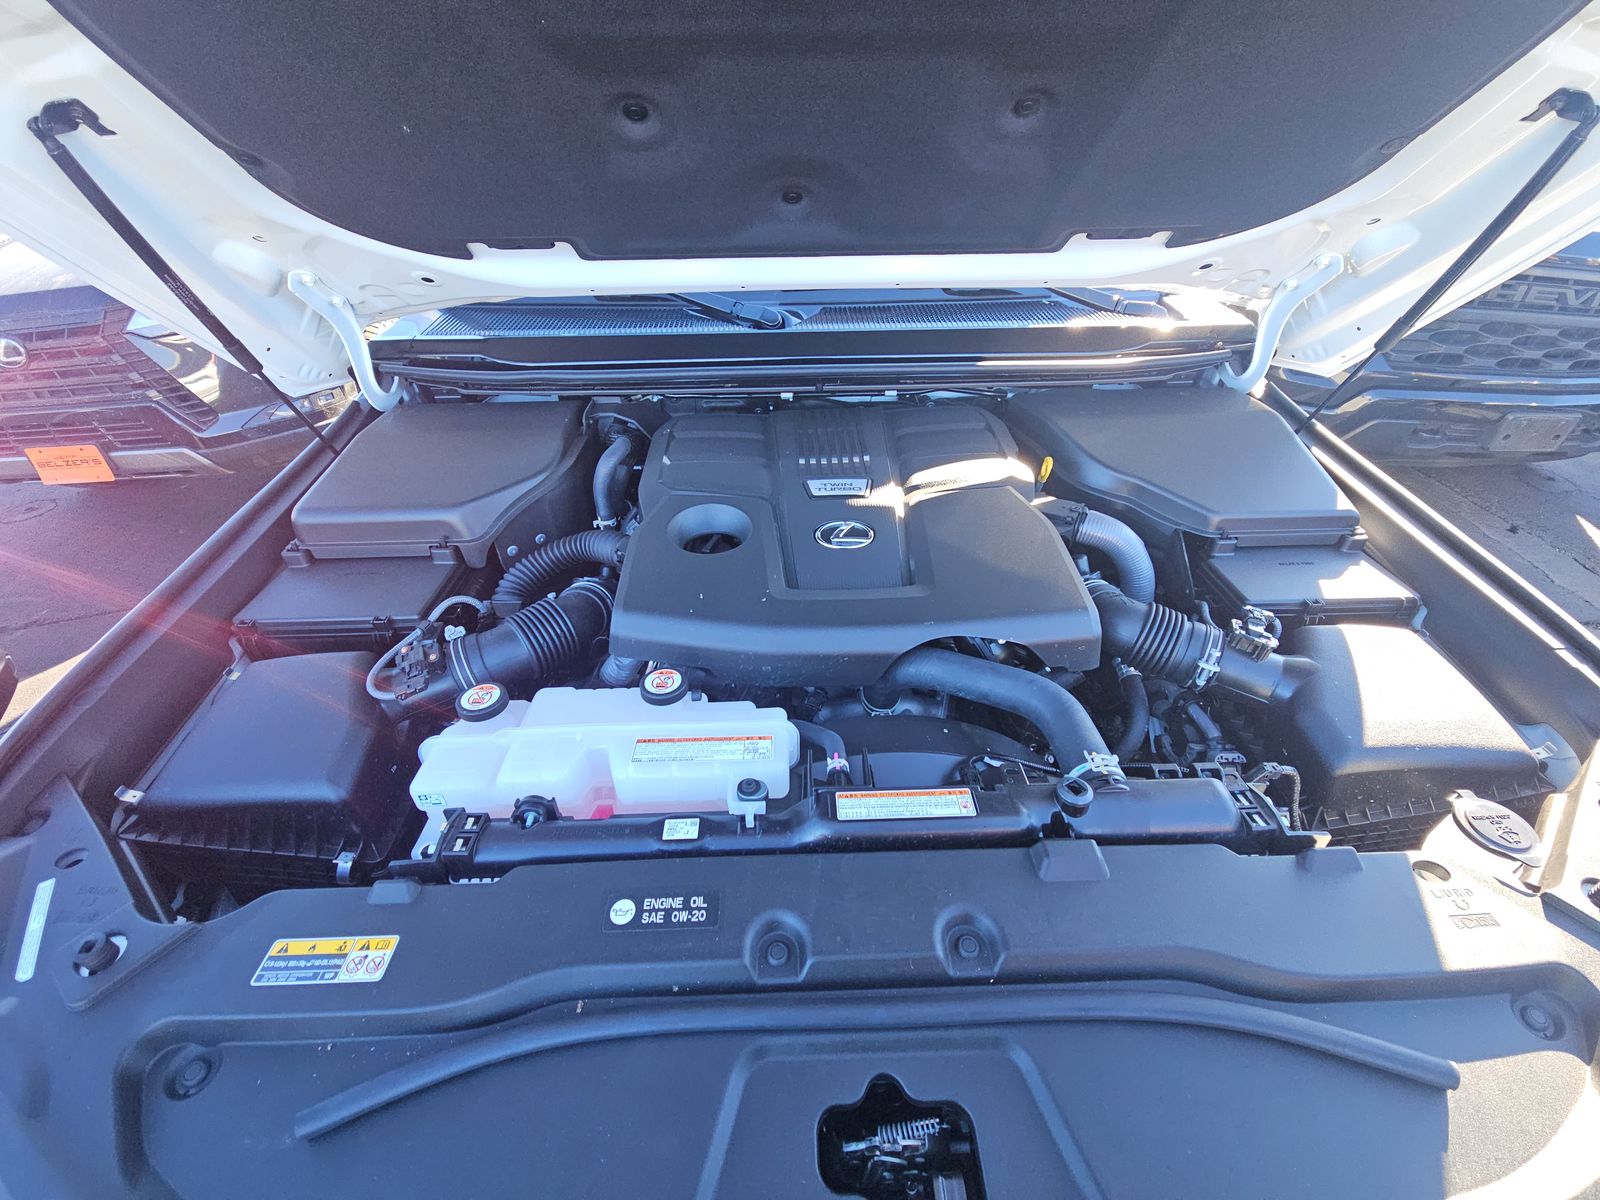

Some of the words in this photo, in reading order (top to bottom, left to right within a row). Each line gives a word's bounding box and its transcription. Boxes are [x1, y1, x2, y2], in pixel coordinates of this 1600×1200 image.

[1480, 285, 1600, 307] HEV
[36, 458, 102, 468] BELZER'S
[643, 897, 684, 910] ENGINE
[690, 896, 708, 908] OIL
[641, 912, 665, 924] SAE
[671, 910, 706, 922] 0W-20
